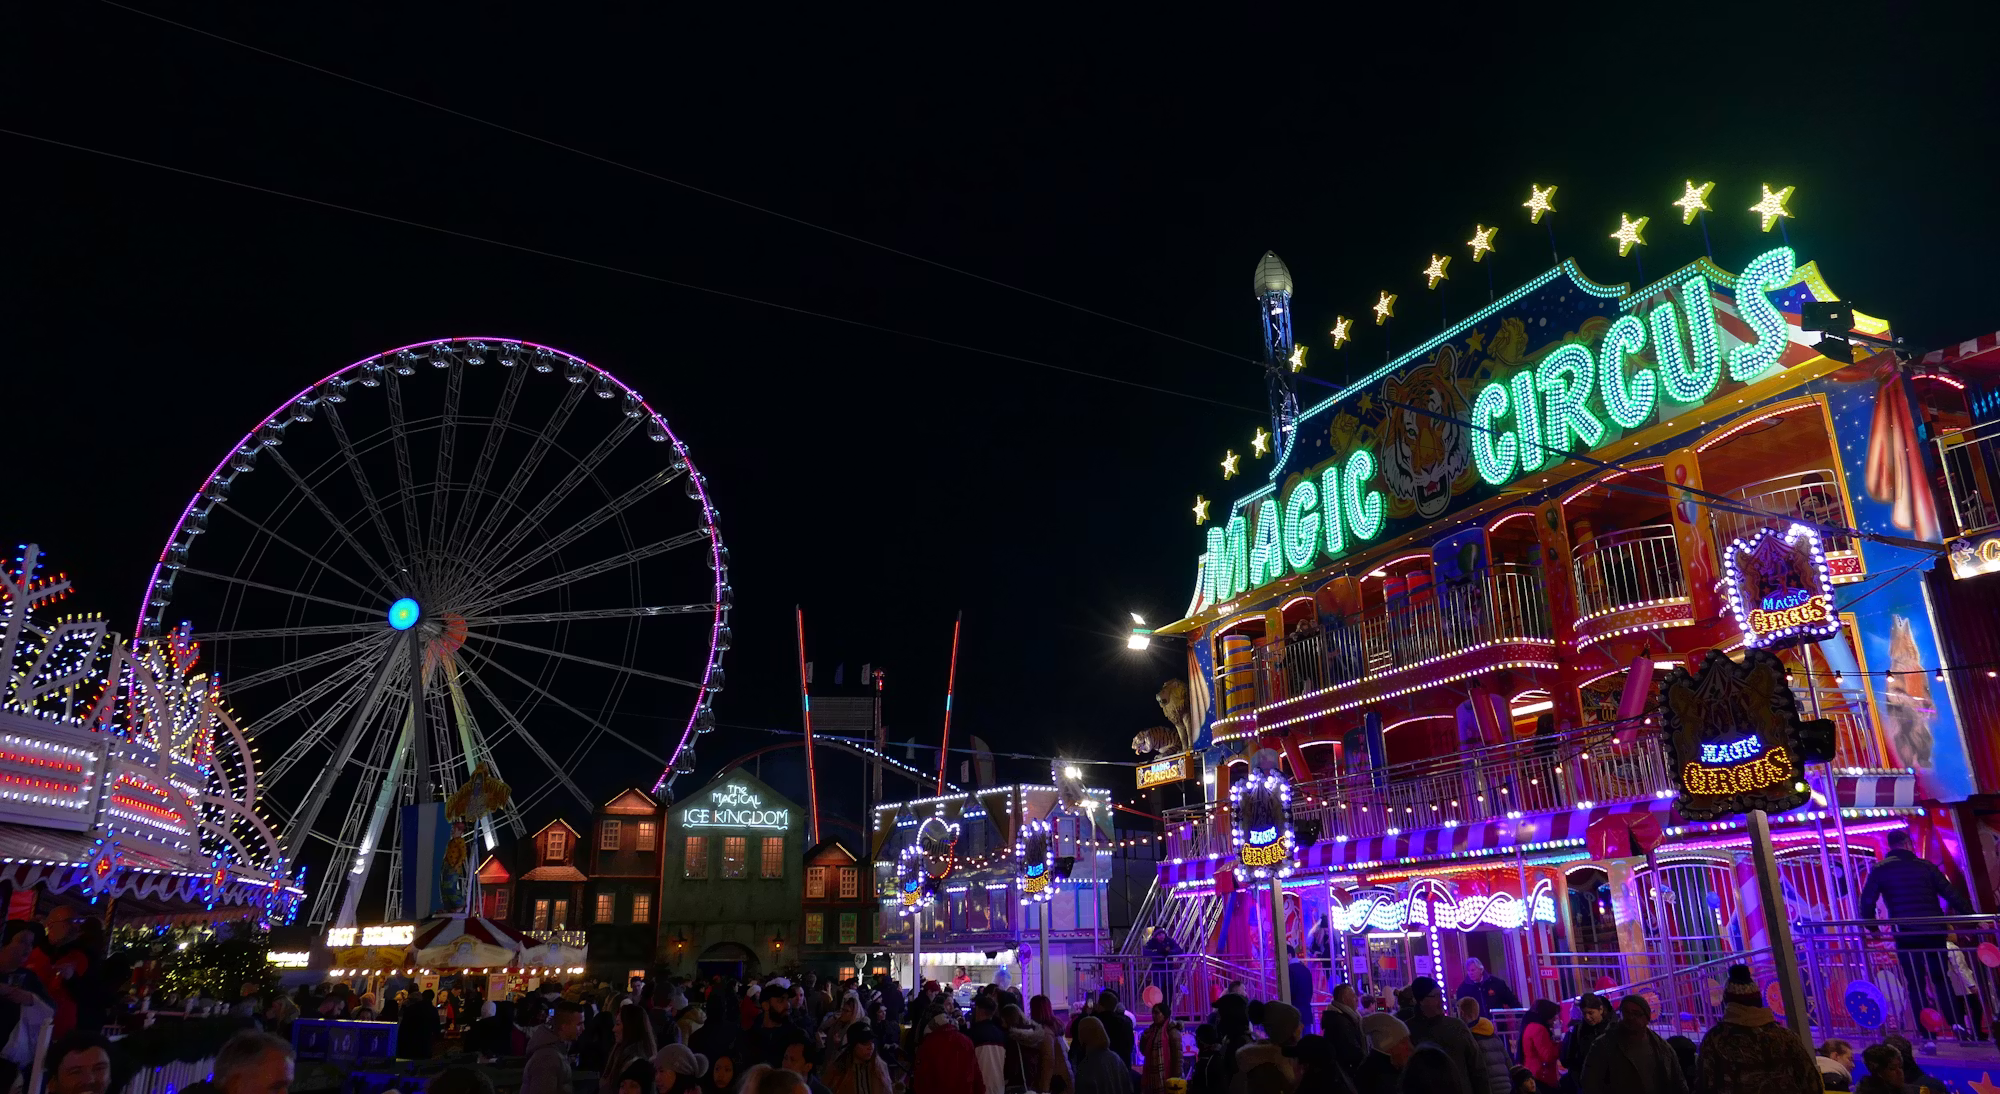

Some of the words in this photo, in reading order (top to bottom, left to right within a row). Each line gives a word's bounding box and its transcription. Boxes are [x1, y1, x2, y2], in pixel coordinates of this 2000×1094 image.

[1203, 450, 1386, 606] MAGIC
[1471, 246, 1797, 486] CIRCUS
[1763, 589, 1810, 610] MAGIC
[1746, 594, 1827, 635] CIRCUS
[1701, 735, 1761, 762] MAGIC
[1144, 764, 1179, 783] CIRCUS
[1151, 761, 1171, 773] MAGIC
[1684, 746, 1792, 795] CIRCUS
[727, 785, 748, 795] The
[712, 792, 761, 809] MAGICAL
[684, 808, 710, 823] ICE
[714, 808, 789, 826] KINGDOM
[1249, 826, 1277, 845] MAGIC
[1242, 836, 1287, 866] CIRCUS
[326, 927, 358, 947] HOT
